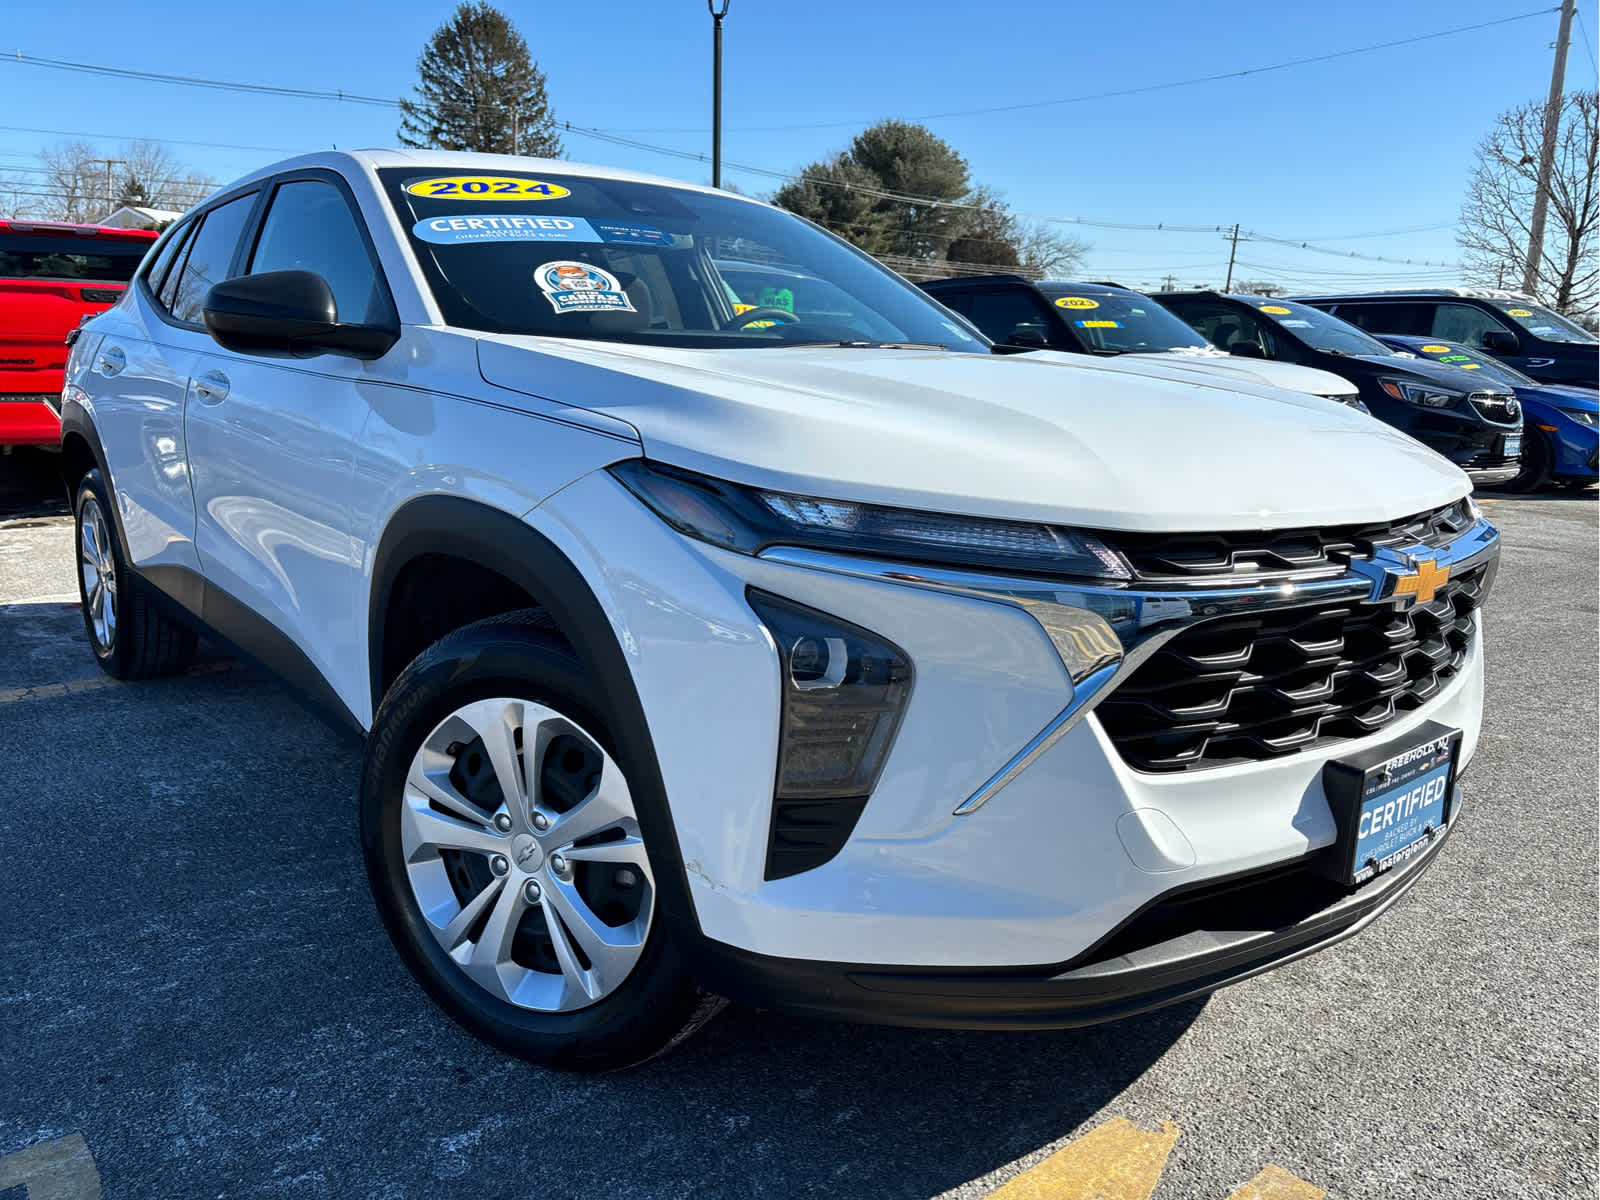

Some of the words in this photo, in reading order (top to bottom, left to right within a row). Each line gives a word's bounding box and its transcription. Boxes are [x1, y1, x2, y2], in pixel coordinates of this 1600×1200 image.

[430, 181, 555, 196] 2024
[429, 217, 575, 232] CERTIFIED
[558, 294, 620, 303] CARFAX
[1357, 775, 1447, 840] CERTIFIED
[1384, 822, 1409, 839] BACKED
